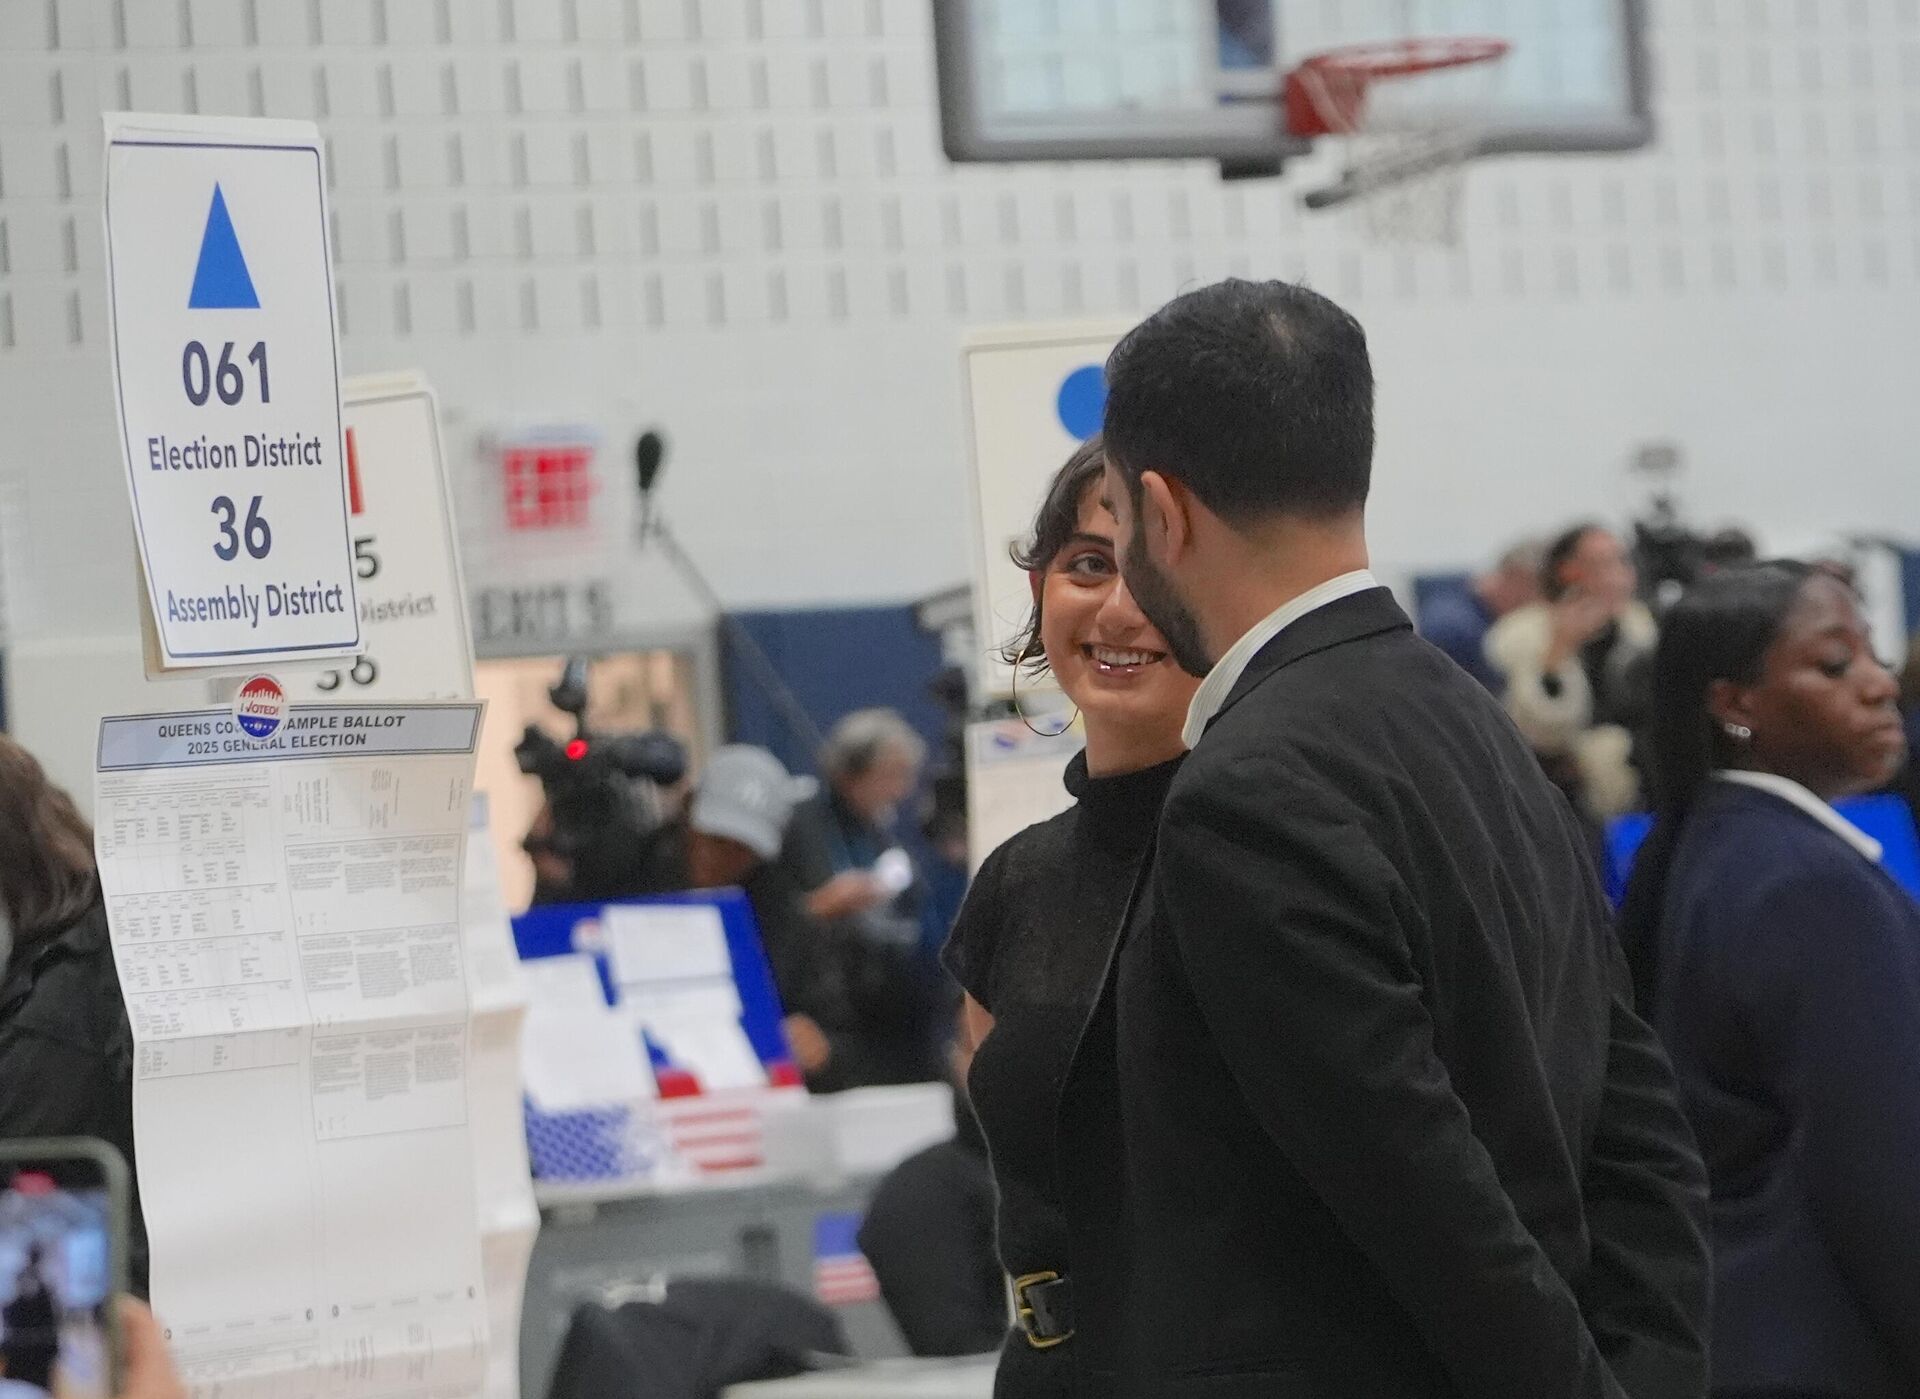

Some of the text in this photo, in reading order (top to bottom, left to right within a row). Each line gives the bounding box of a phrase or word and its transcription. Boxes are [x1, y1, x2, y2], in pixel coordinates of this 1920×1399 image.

[182, 340, 271, 407] 061
[148, 432, 322, 471] Election District
[211, 495, 272, 562] 36
[167, 580, 344, 629] Assembly District
[158, 722, 211, 738] QUEENS
[343, 715, 406, 728] BALLOT
[187, 741, 219, 754] 2025
[291, 733, 367, 750] ELECTION
